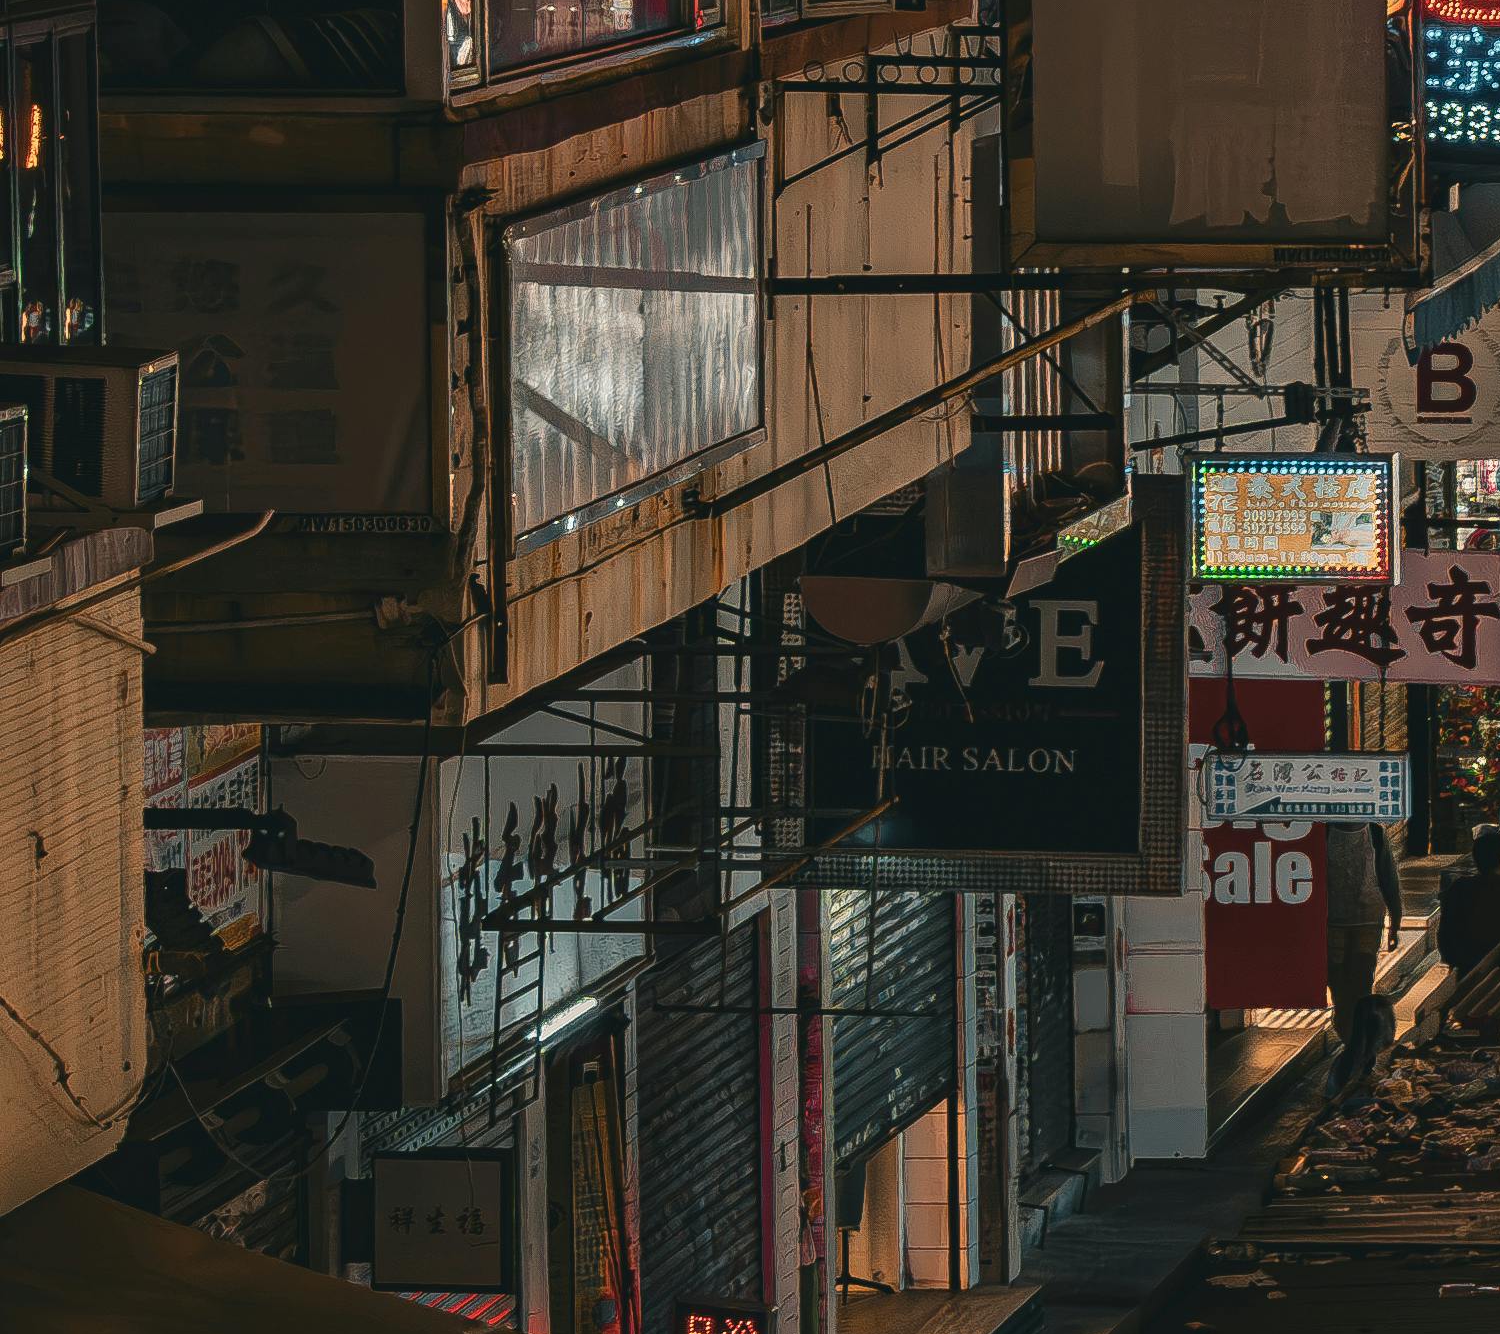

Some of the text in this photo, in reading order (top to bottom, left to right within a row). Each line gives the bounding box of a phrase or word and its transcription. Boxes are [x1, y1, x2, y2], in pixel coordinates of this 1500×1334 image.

[1416, 344, 1475, 412] B
[873, 746, 1078, 773] HAIR SALON
